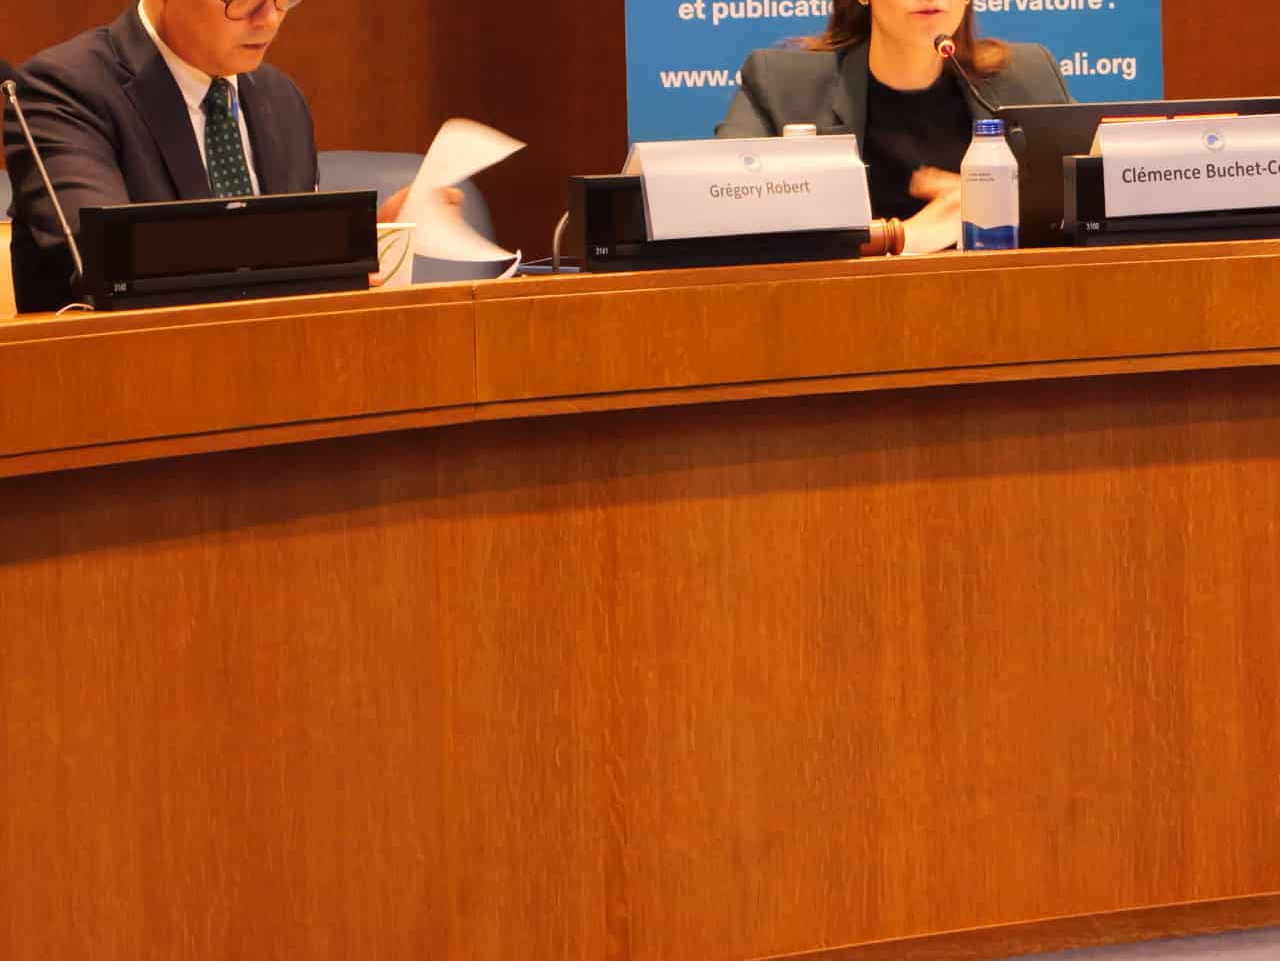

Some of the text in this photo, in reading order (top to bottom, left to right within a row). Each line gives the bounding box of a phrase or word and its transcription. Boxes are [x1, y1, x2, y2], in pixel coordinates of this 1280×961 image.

[1121, 166, 1201, 184] Clémence
[709, 179, 811, 200] Grégory Robert
